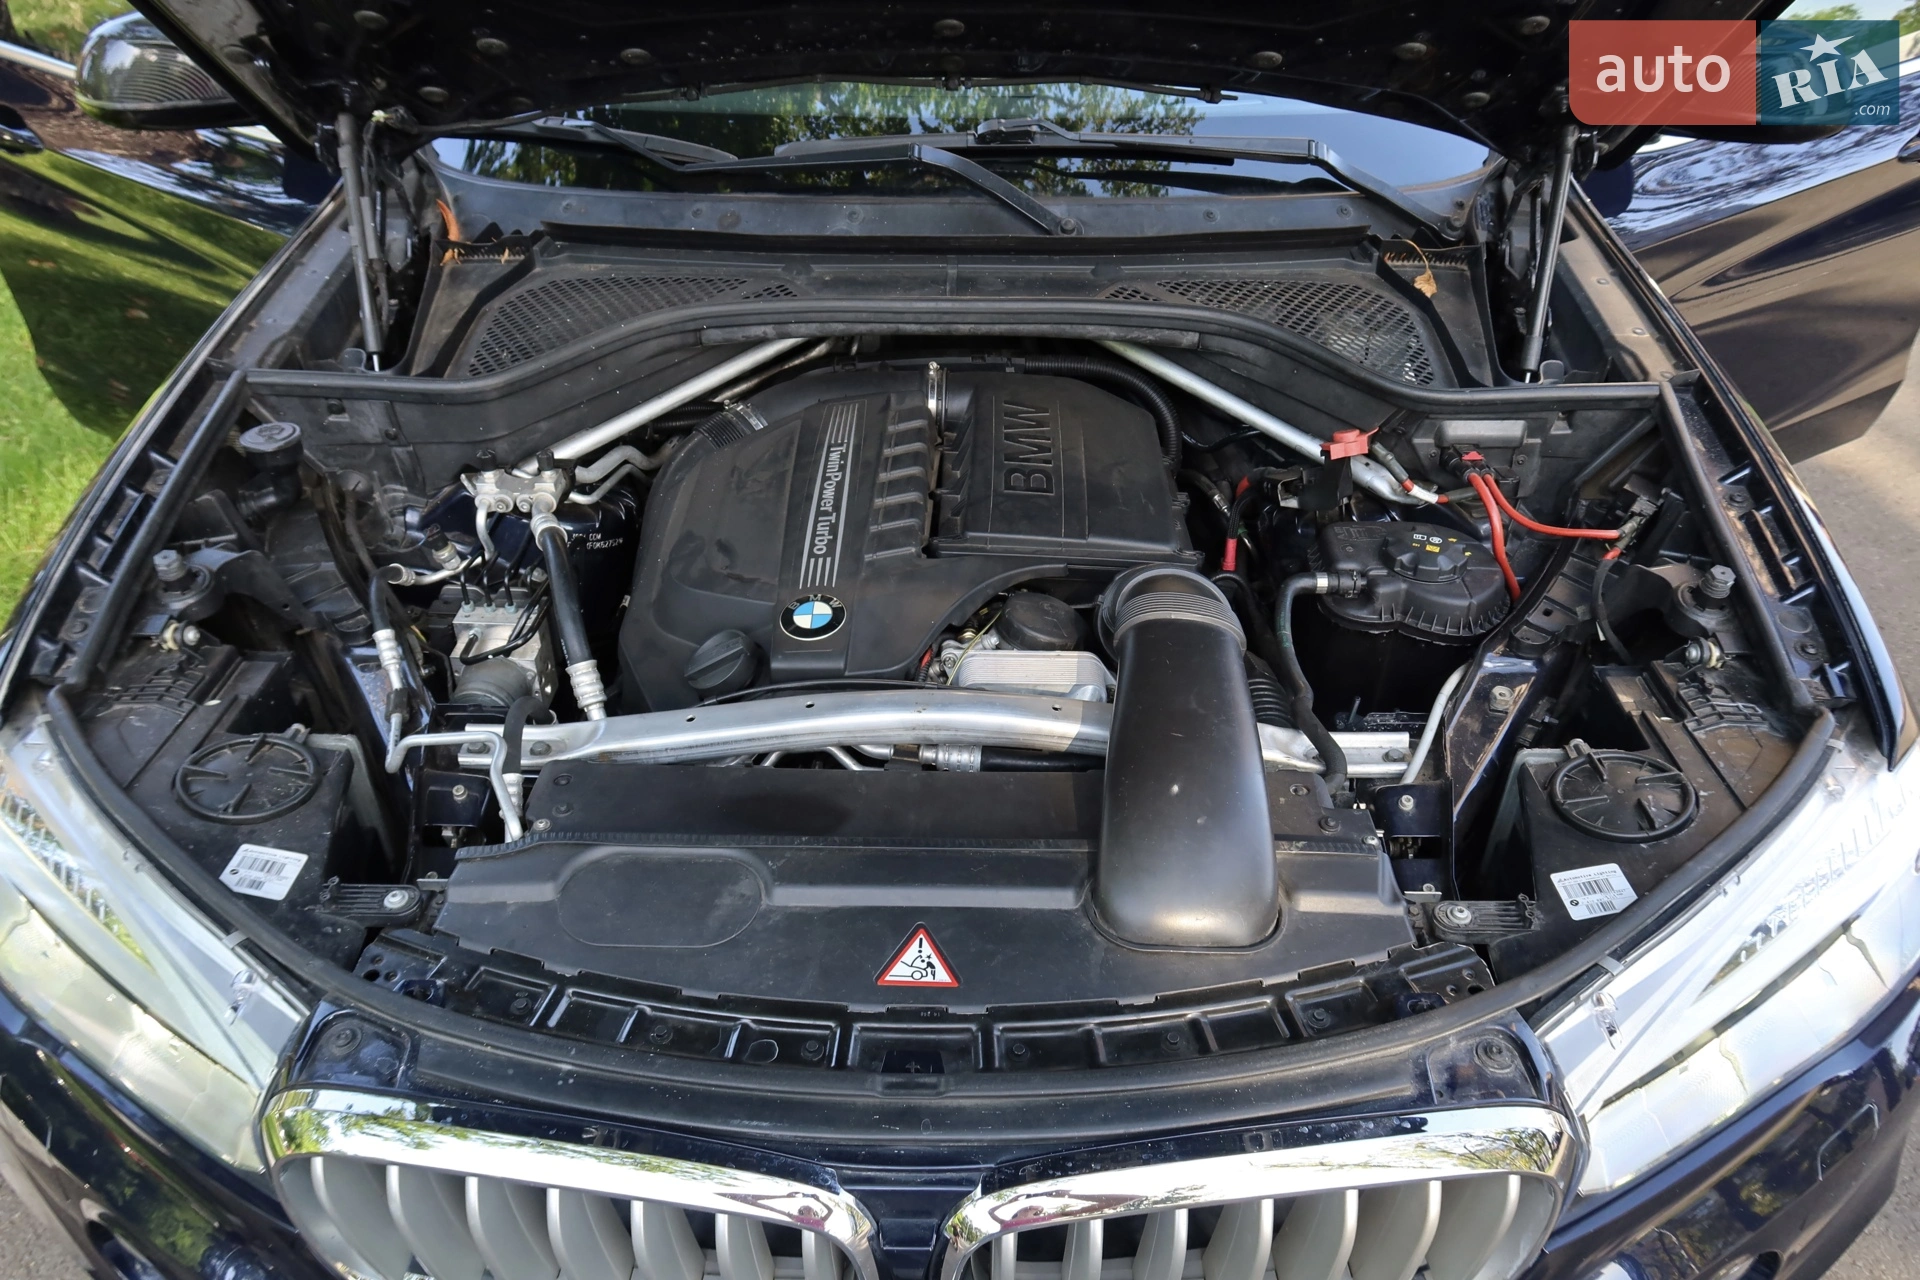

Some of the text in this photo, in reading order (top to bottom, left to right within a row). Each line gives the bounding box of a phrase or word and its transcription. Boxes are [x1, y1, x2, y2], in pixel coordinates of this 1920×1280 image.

[1003, 400, 1055, 496] BMW
[813, 442, 847, 554] TwinPower Turbo
[788, 594, 843, 610] BMW
